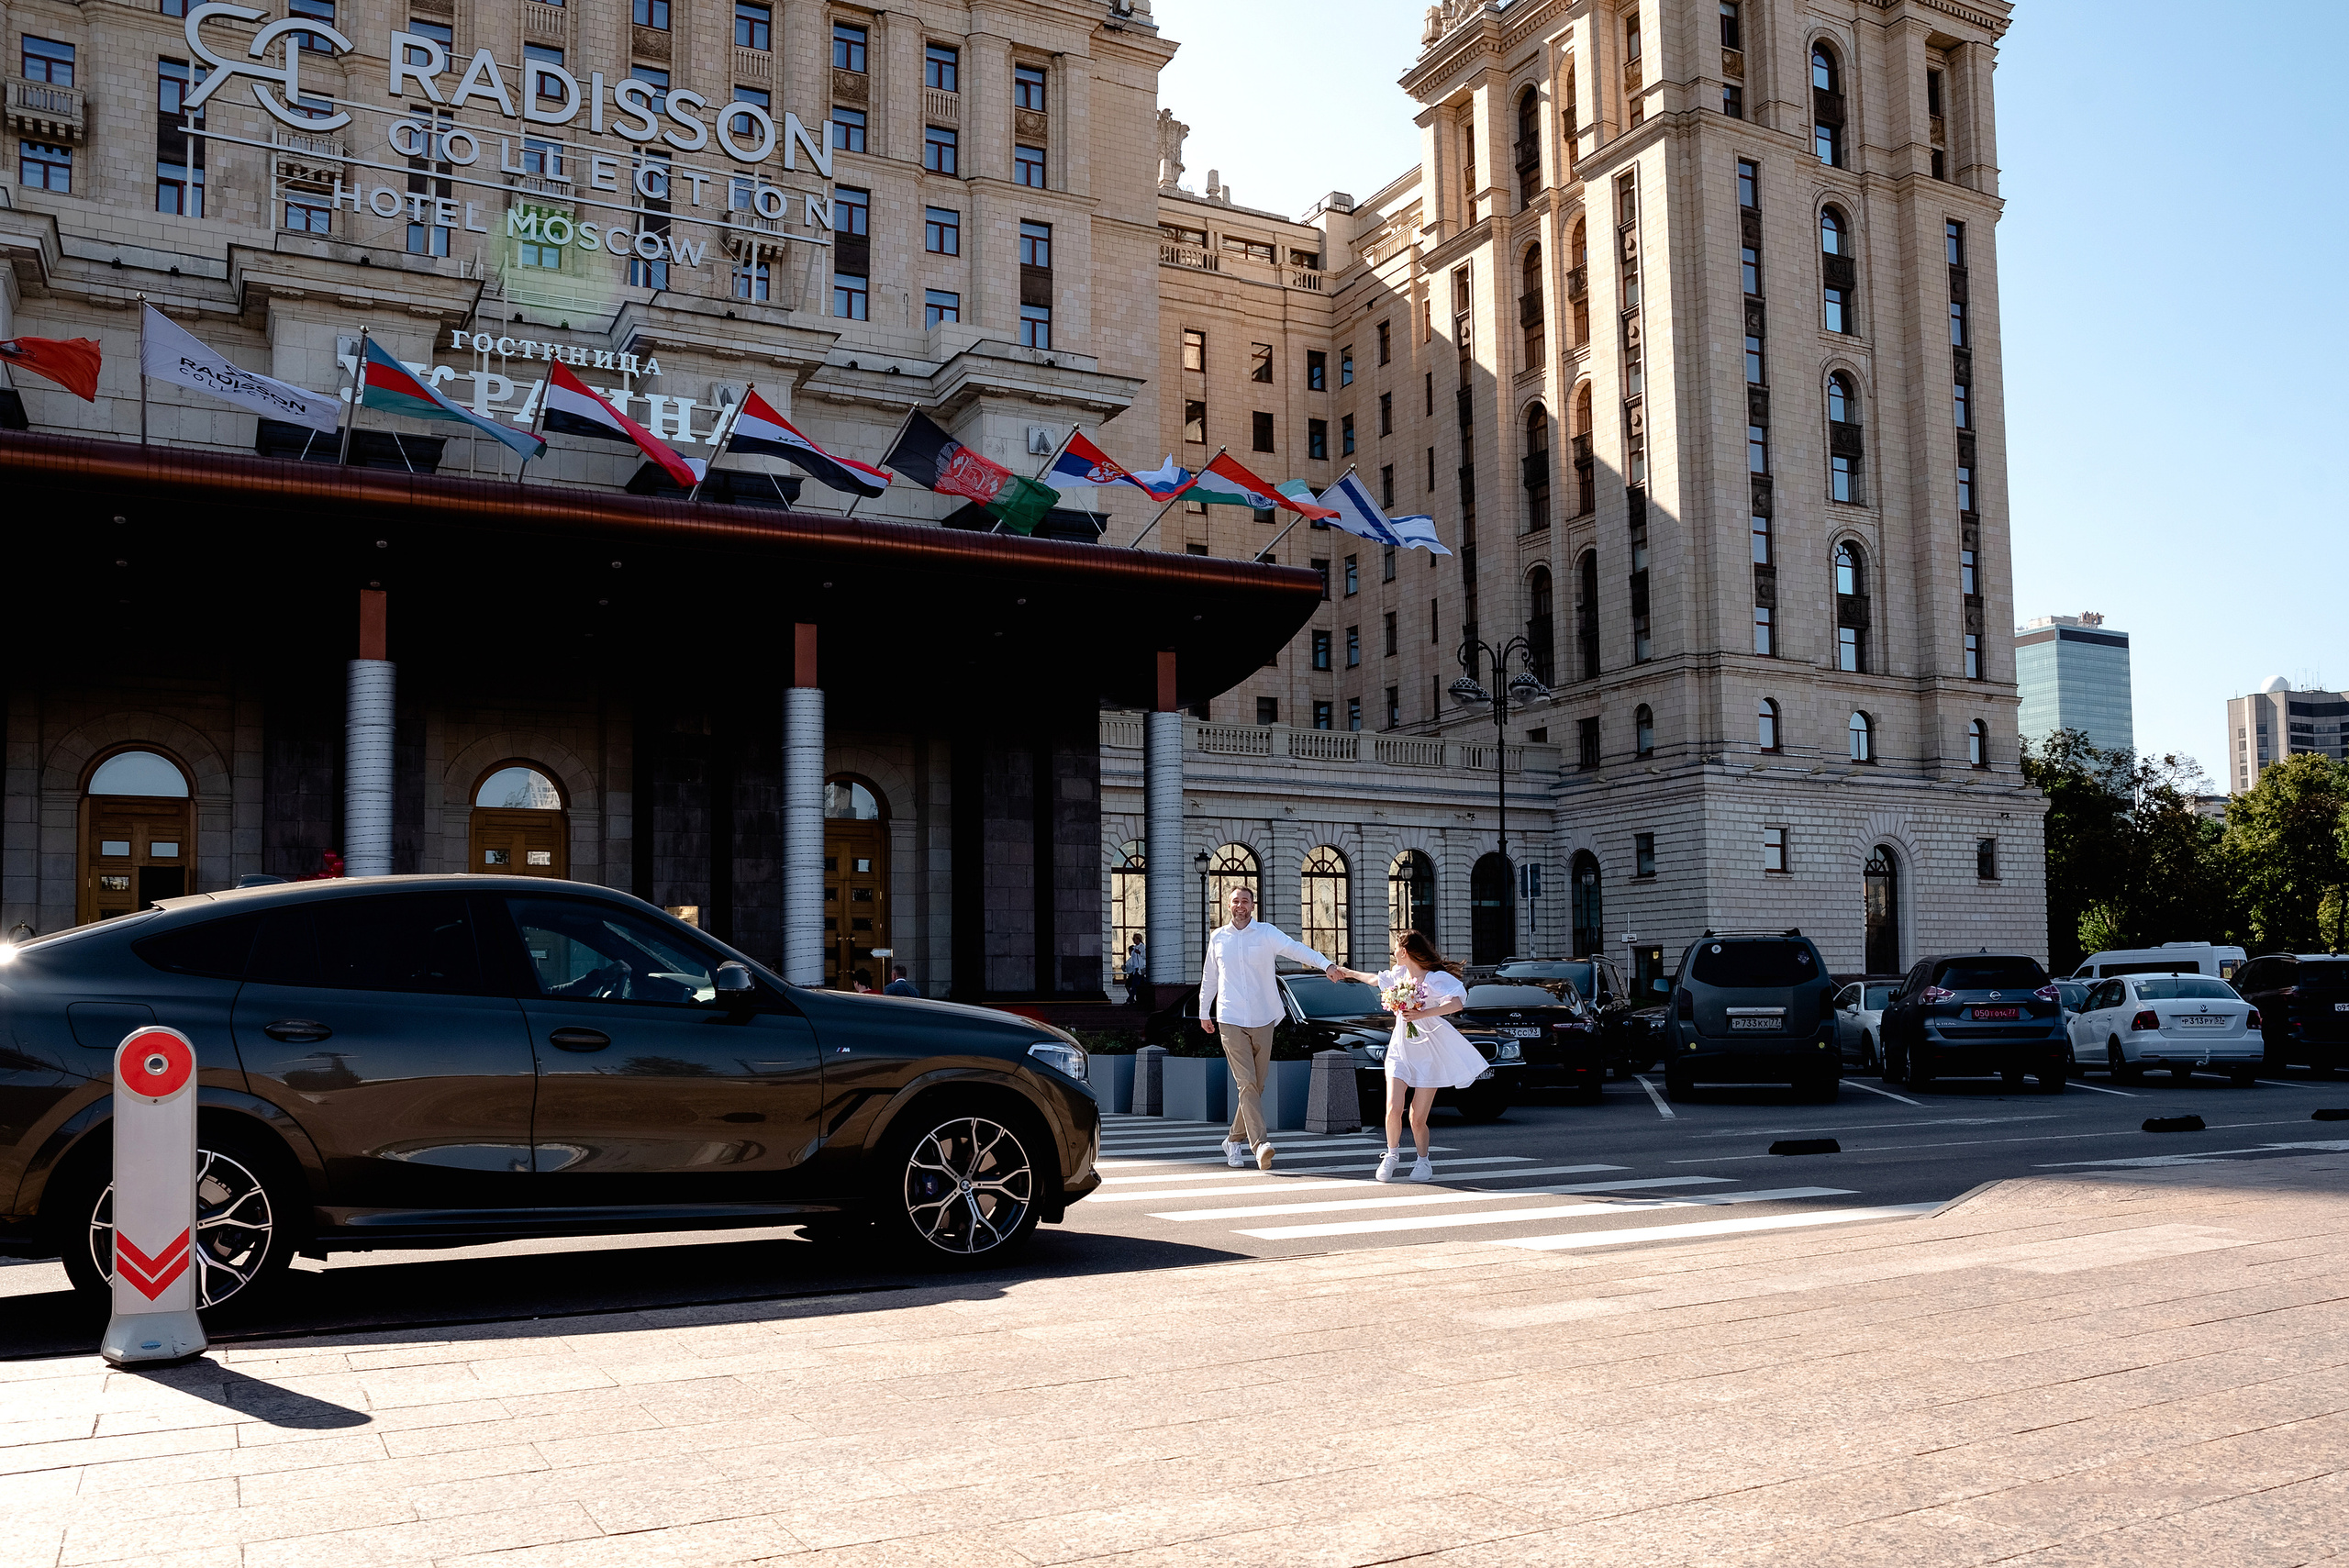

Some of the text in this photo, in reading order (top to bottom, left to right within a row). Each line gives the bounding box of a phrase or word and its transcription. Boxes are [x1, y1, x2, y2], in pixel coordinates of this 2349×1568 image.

[388, 29, 833, 180] RADISSON
[388, 119, 833, 230] COLLECTION
[333, 179, 707, 268] HOTEL MOSCOW
[180, 356, 306, 413] RADISSON
[451, 328, 663, 378] ГОСТИНИЦА
